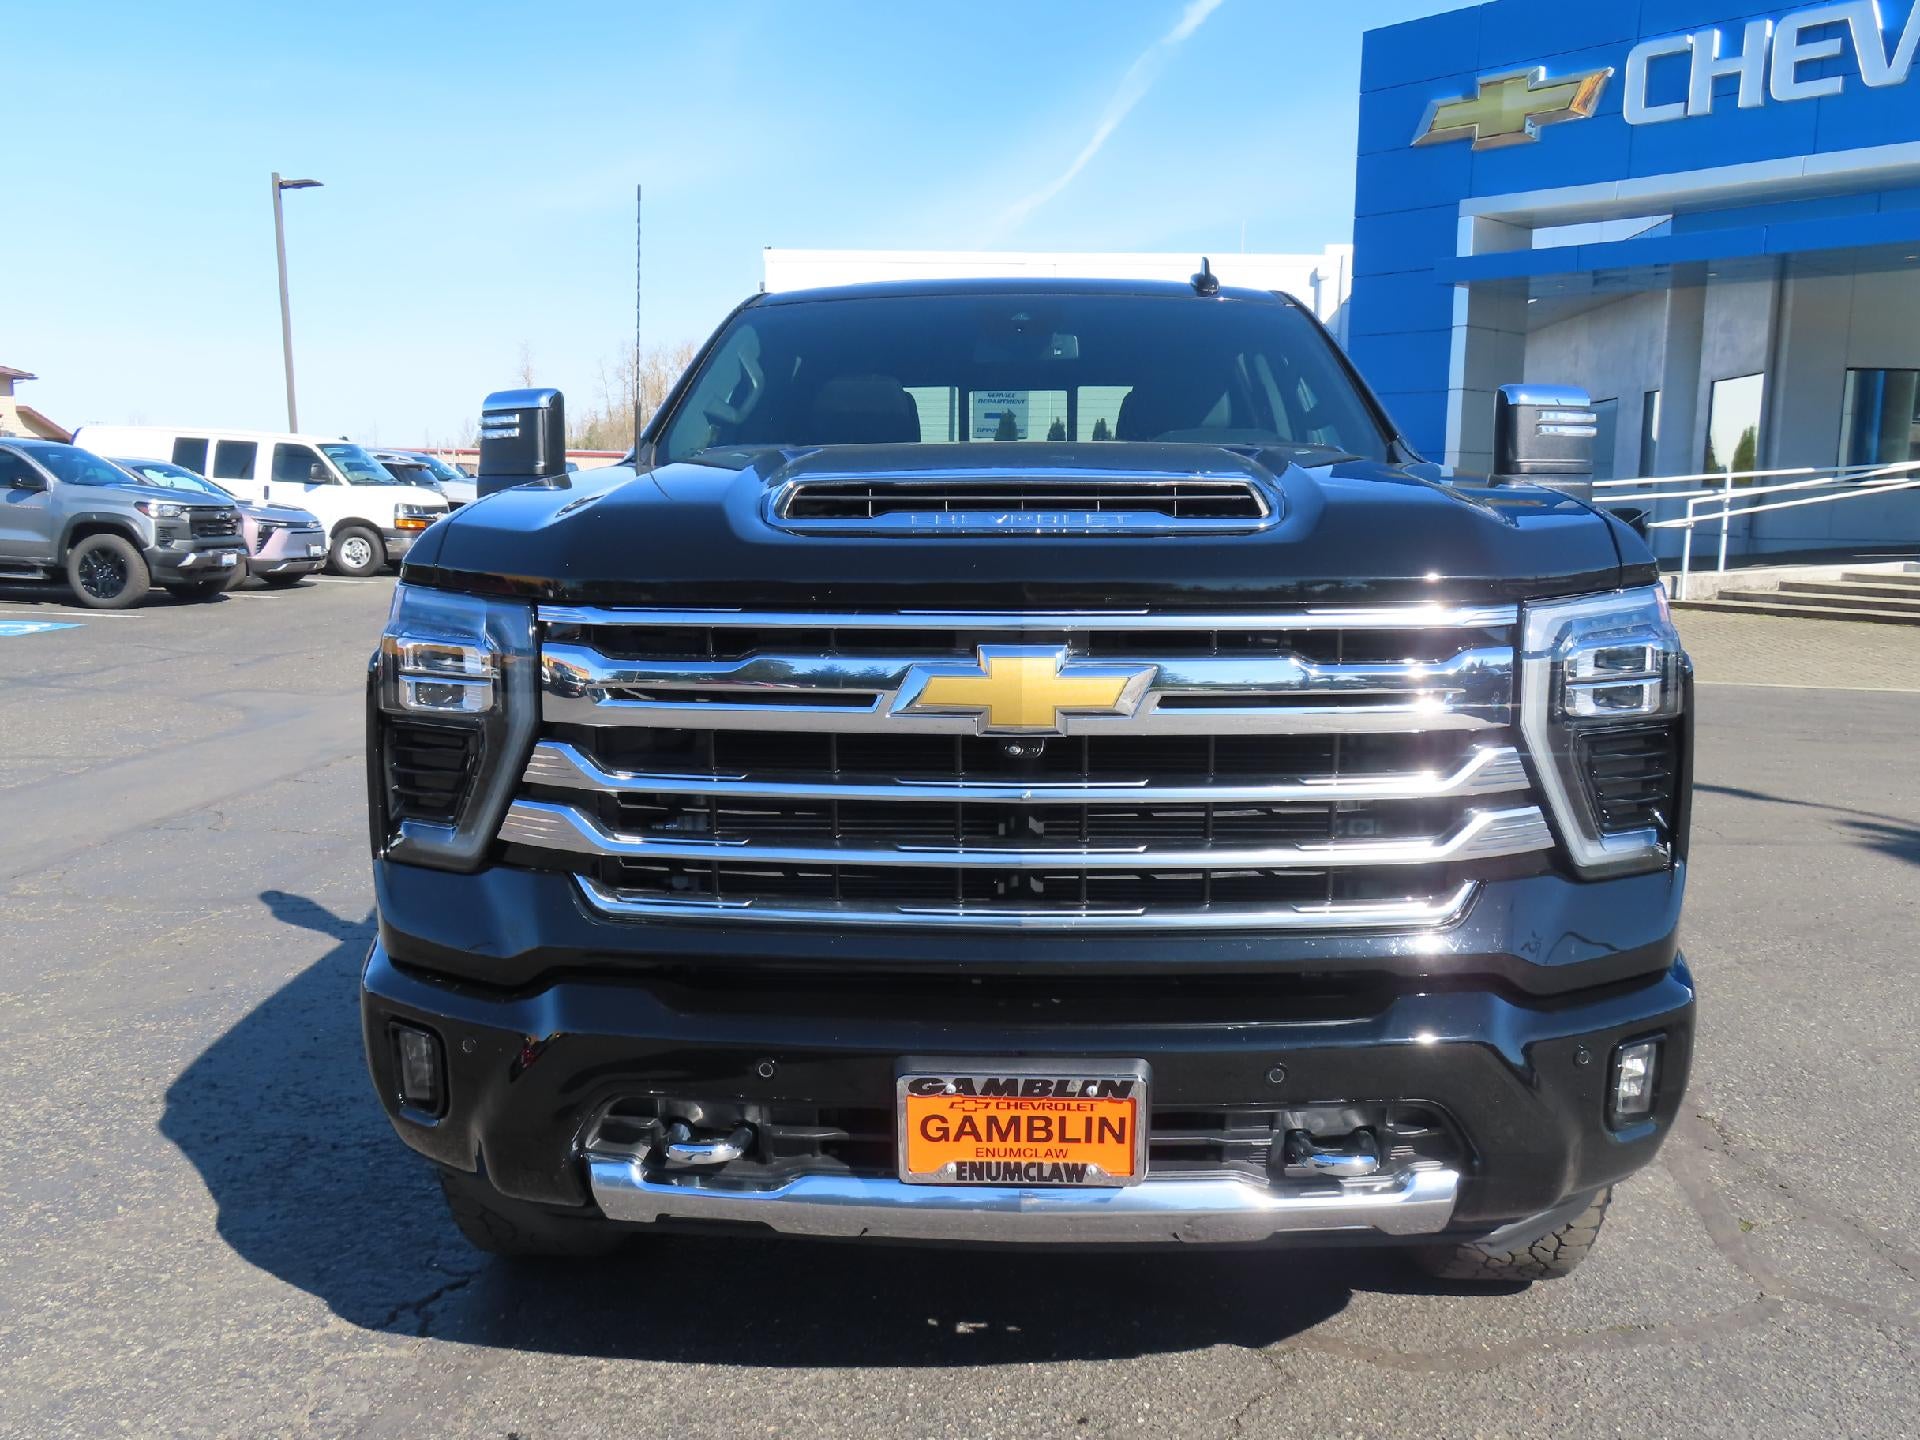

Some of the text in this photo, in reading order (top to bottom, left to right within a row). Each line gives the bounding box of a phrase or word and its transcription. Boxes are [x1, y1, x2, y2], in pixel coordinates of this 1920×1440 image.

[1623, 0, 1920, 126] CHEV
[907, 1077, 1135, 1099] GAMBLIN
[995, 1101, 1098, 1112] CHEVROLET
[919, 1114, 1126, 1145] GAMBLIN
[975, 1147, 1069, 1159] ENUMCLAW
[956, 1160, 1088, 1183] ENUMCLAW
